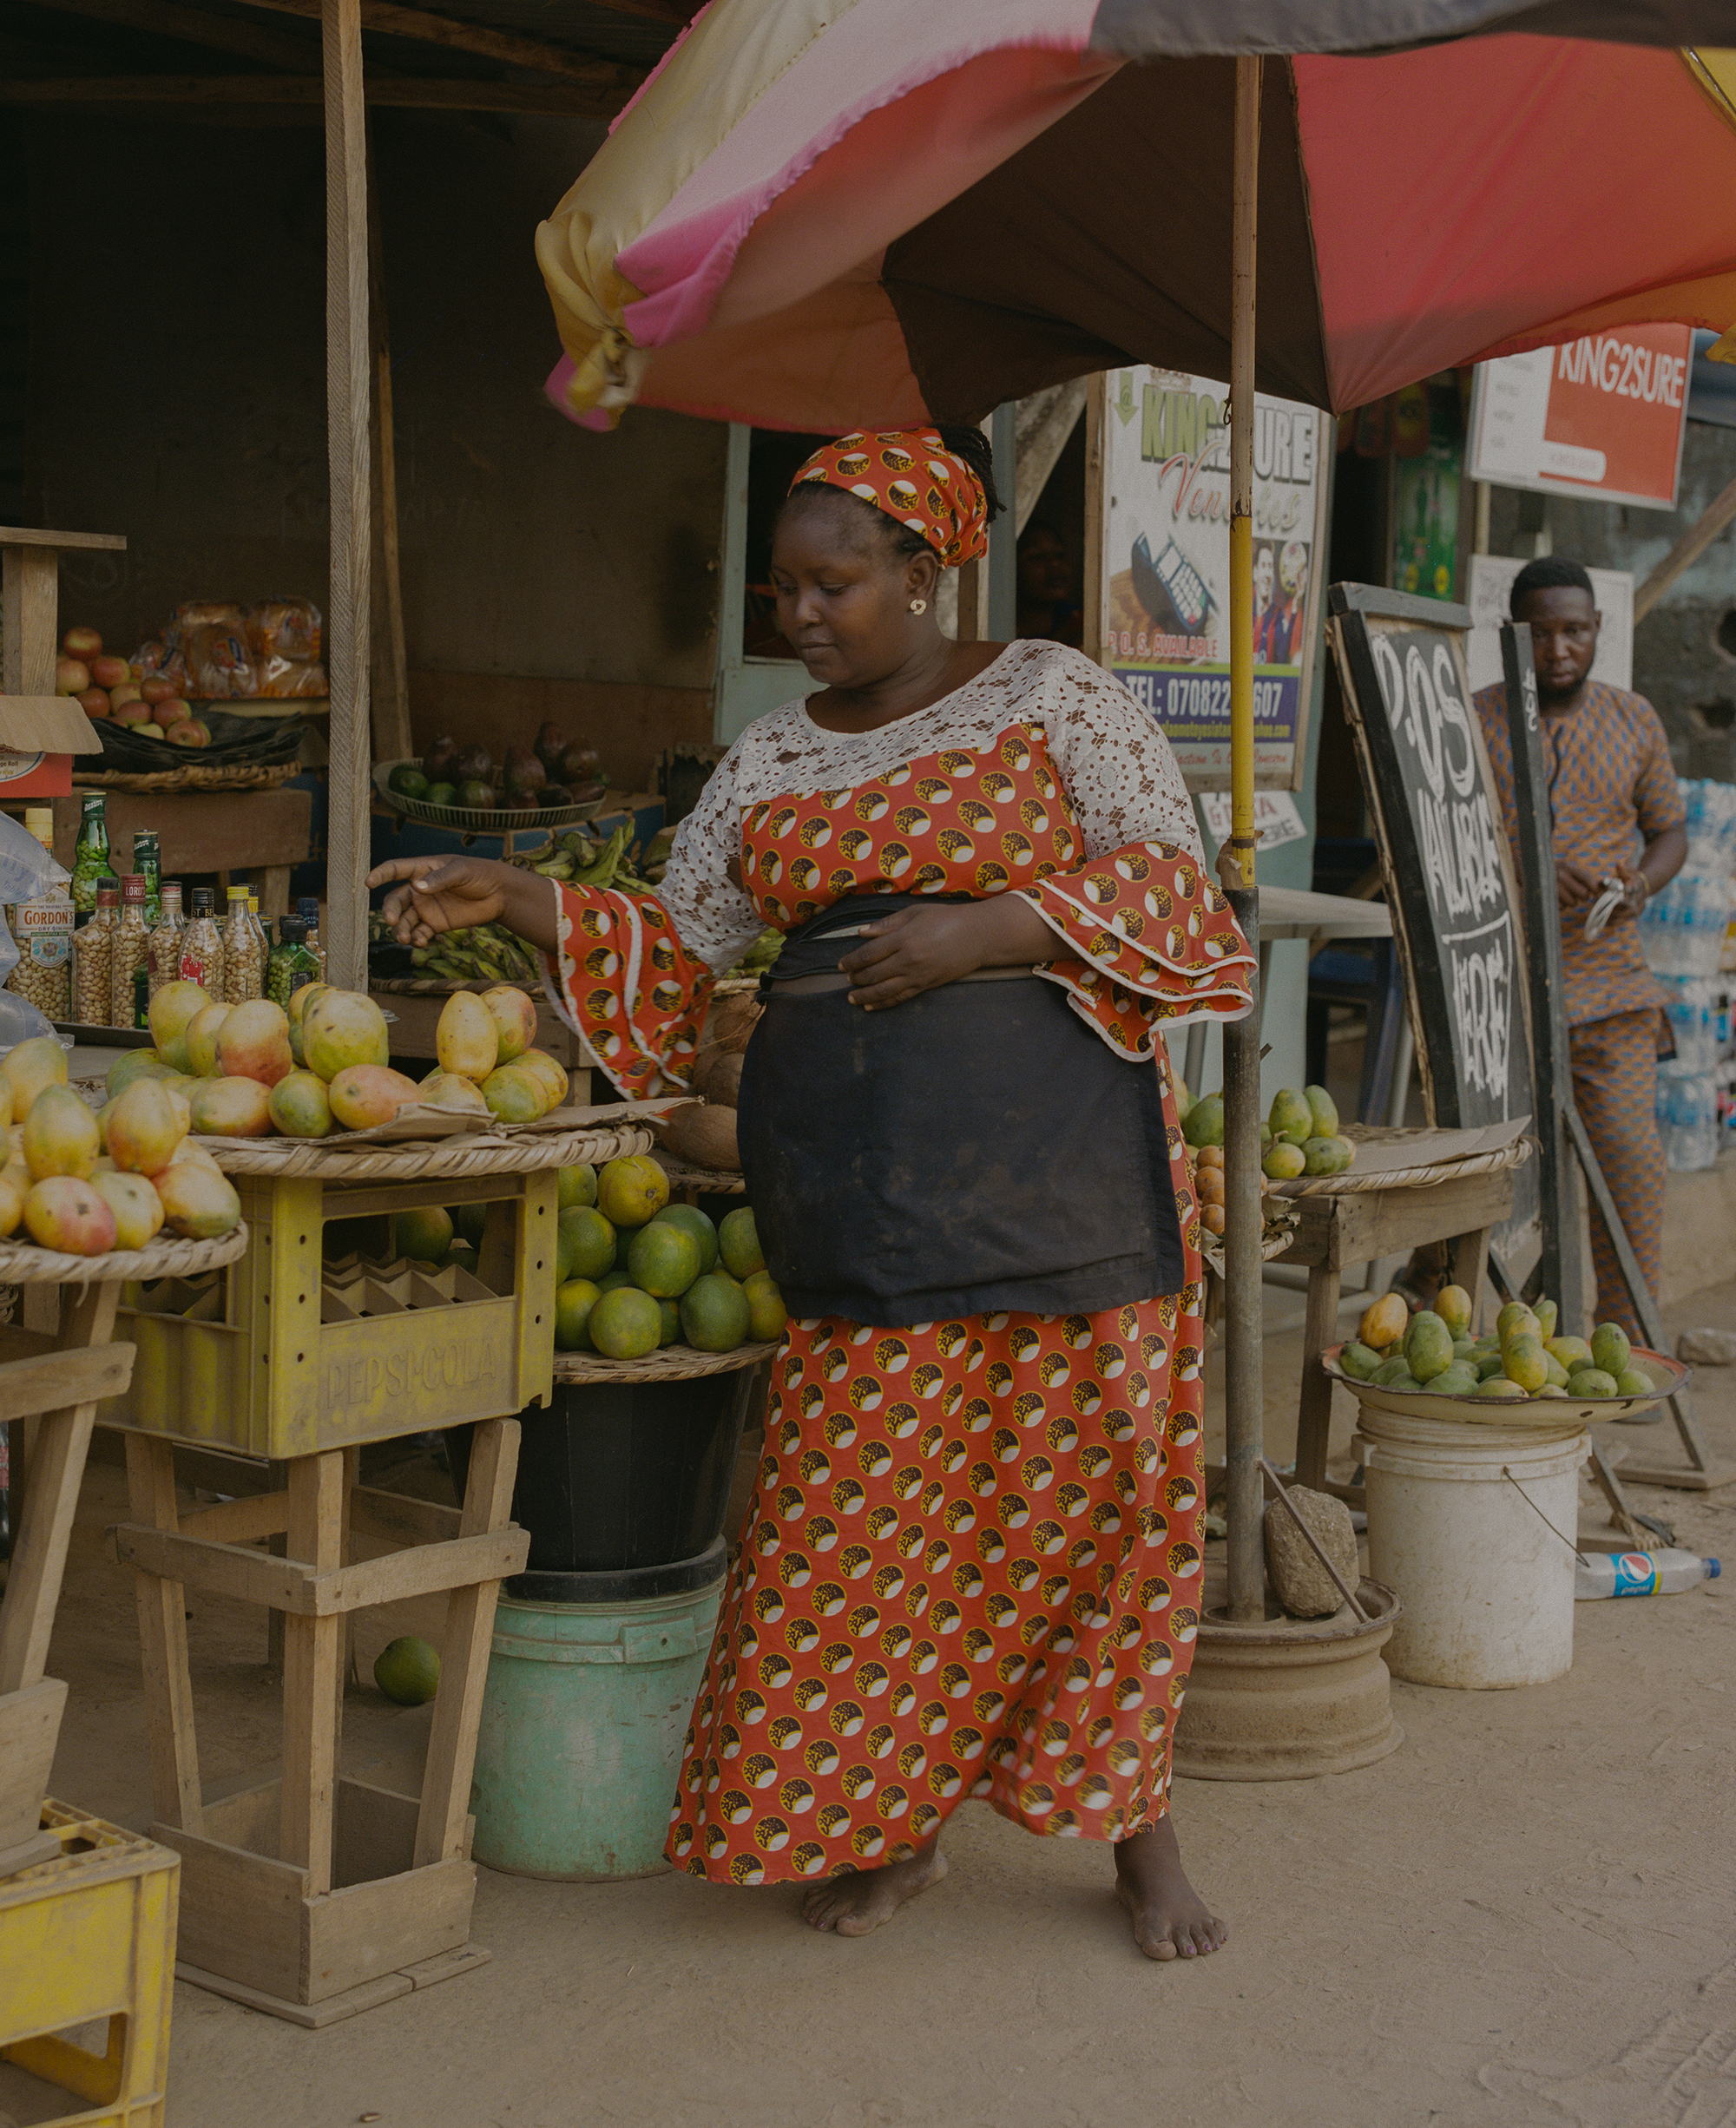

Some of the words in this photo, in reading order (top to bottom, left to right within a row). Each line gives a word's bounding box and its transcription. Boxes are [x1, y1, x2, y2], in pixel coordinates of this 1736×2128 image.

[1558, 336, 1686, 408] KING2SURE
[1141, 384, 1312, 485] KING2URE
[1154, 634, 1219, 659] AVAILABLE
[1167, 678, 1283, 719] 070822607
[23, 910, 74, 925] GORDON'S
